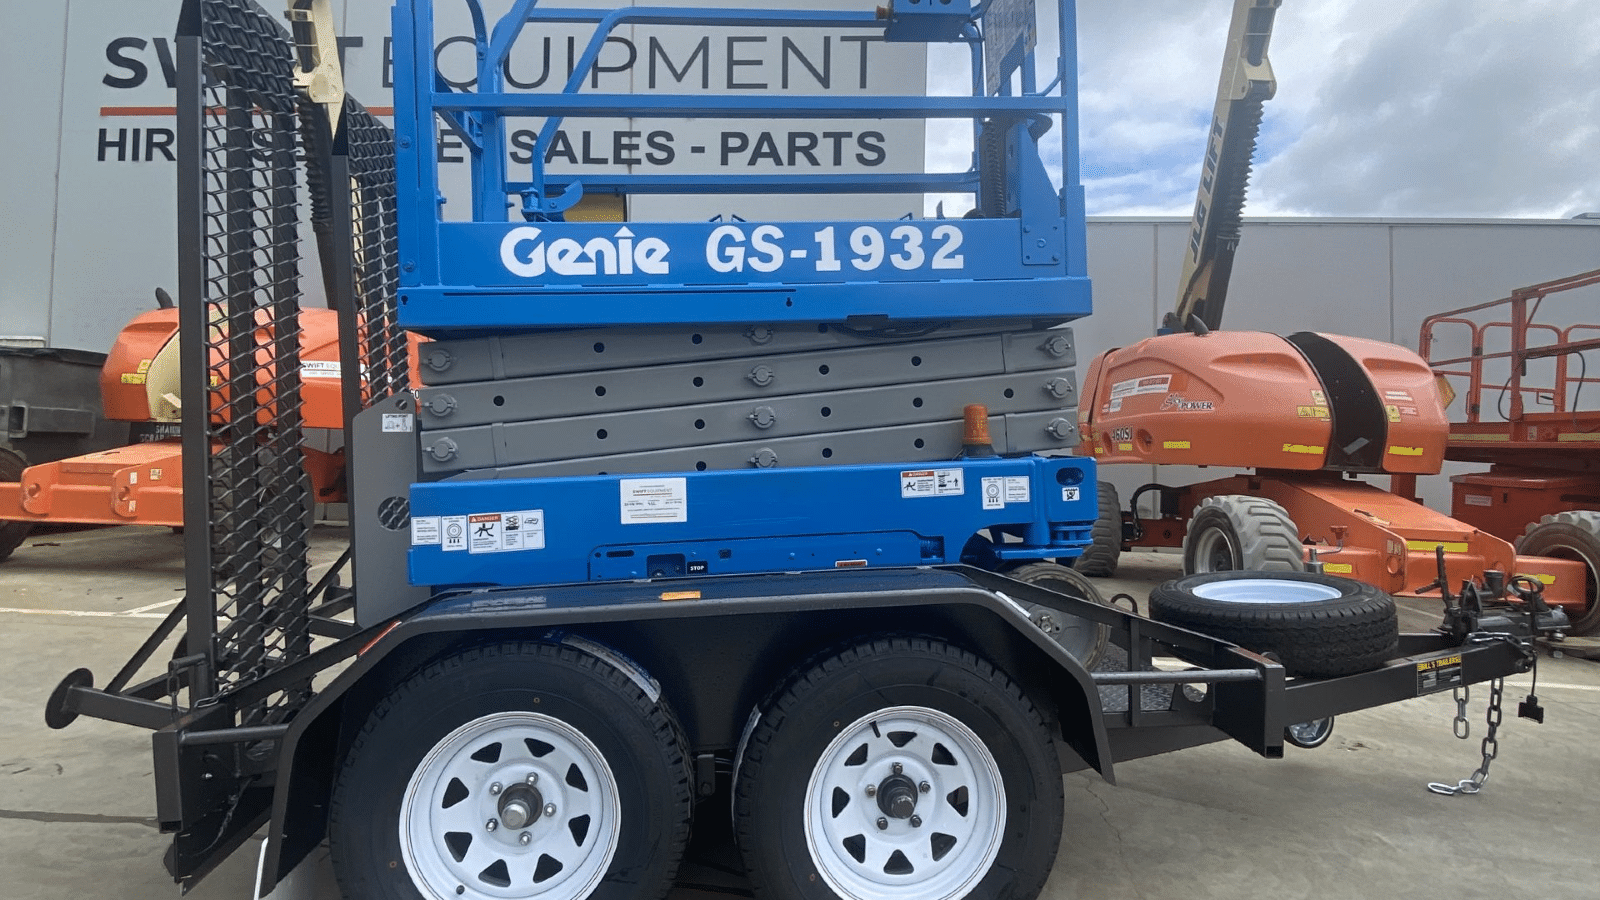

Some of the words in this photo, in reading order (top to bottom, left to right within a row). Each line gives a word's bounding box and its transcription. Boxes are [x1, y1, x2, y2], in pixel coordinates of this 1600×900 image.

[97, 128, 177, 162] HIR
[509, 129, 676, 166] SALES
[720, 130, 887, 167] PARTS
[500, 225, 671, 278] Genie
[705, 224, 965, 274] GS-1932
[477, 514, 499, 522] DANGER
